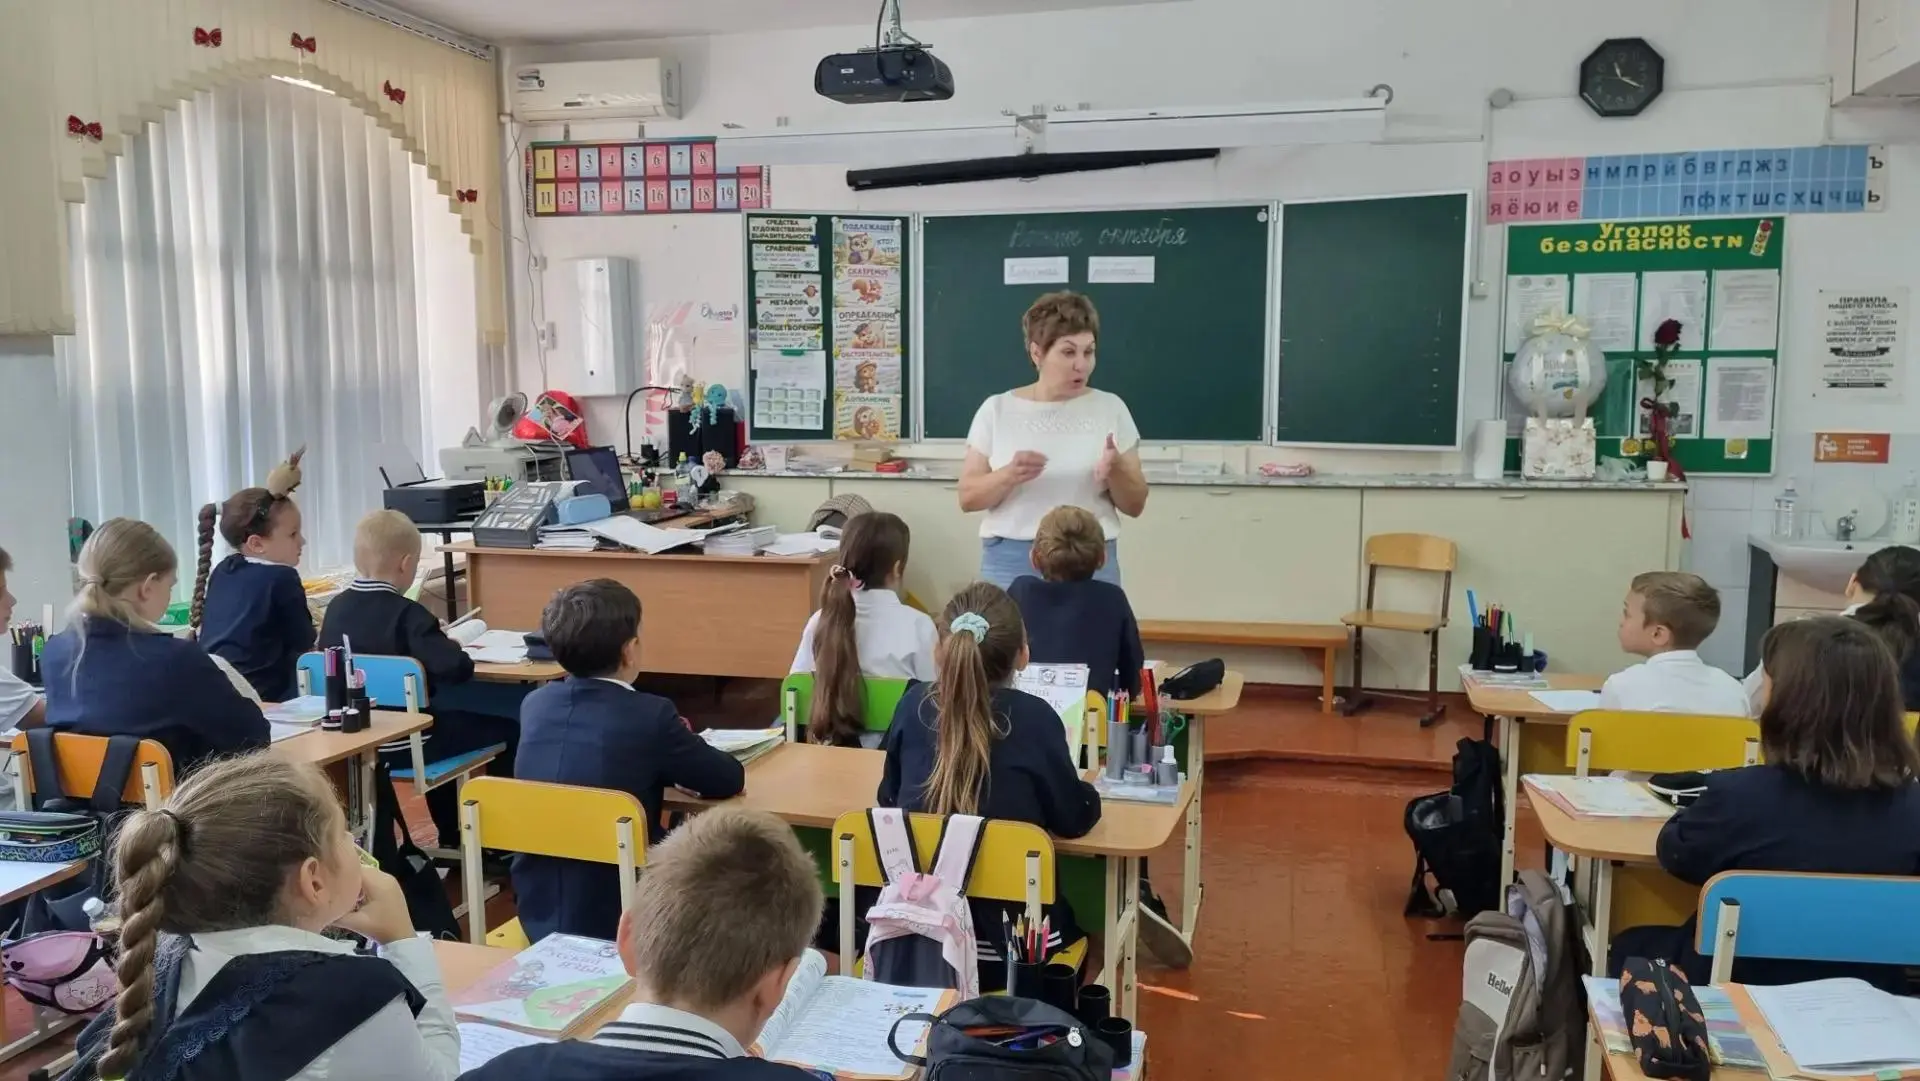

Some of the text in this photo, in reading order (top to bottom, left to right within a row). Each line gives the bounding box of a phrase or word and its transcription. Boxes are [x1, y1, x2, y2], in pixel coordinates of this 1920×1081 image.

[541, 150, 707, 169] 1 2 3 4 5 6 7 8
[1491, 156, 1883, 186] а о у ы э н м л р й б в г д ж з ъ
[541, 186, 757, 205] 11 12 13 14 15 16 17 18 19 20
[1490, 190, 1880, 215] я ё ю и е п ф к т ш с х ц ч щ ь
[1600, 223, 1691, 239] Уголок
